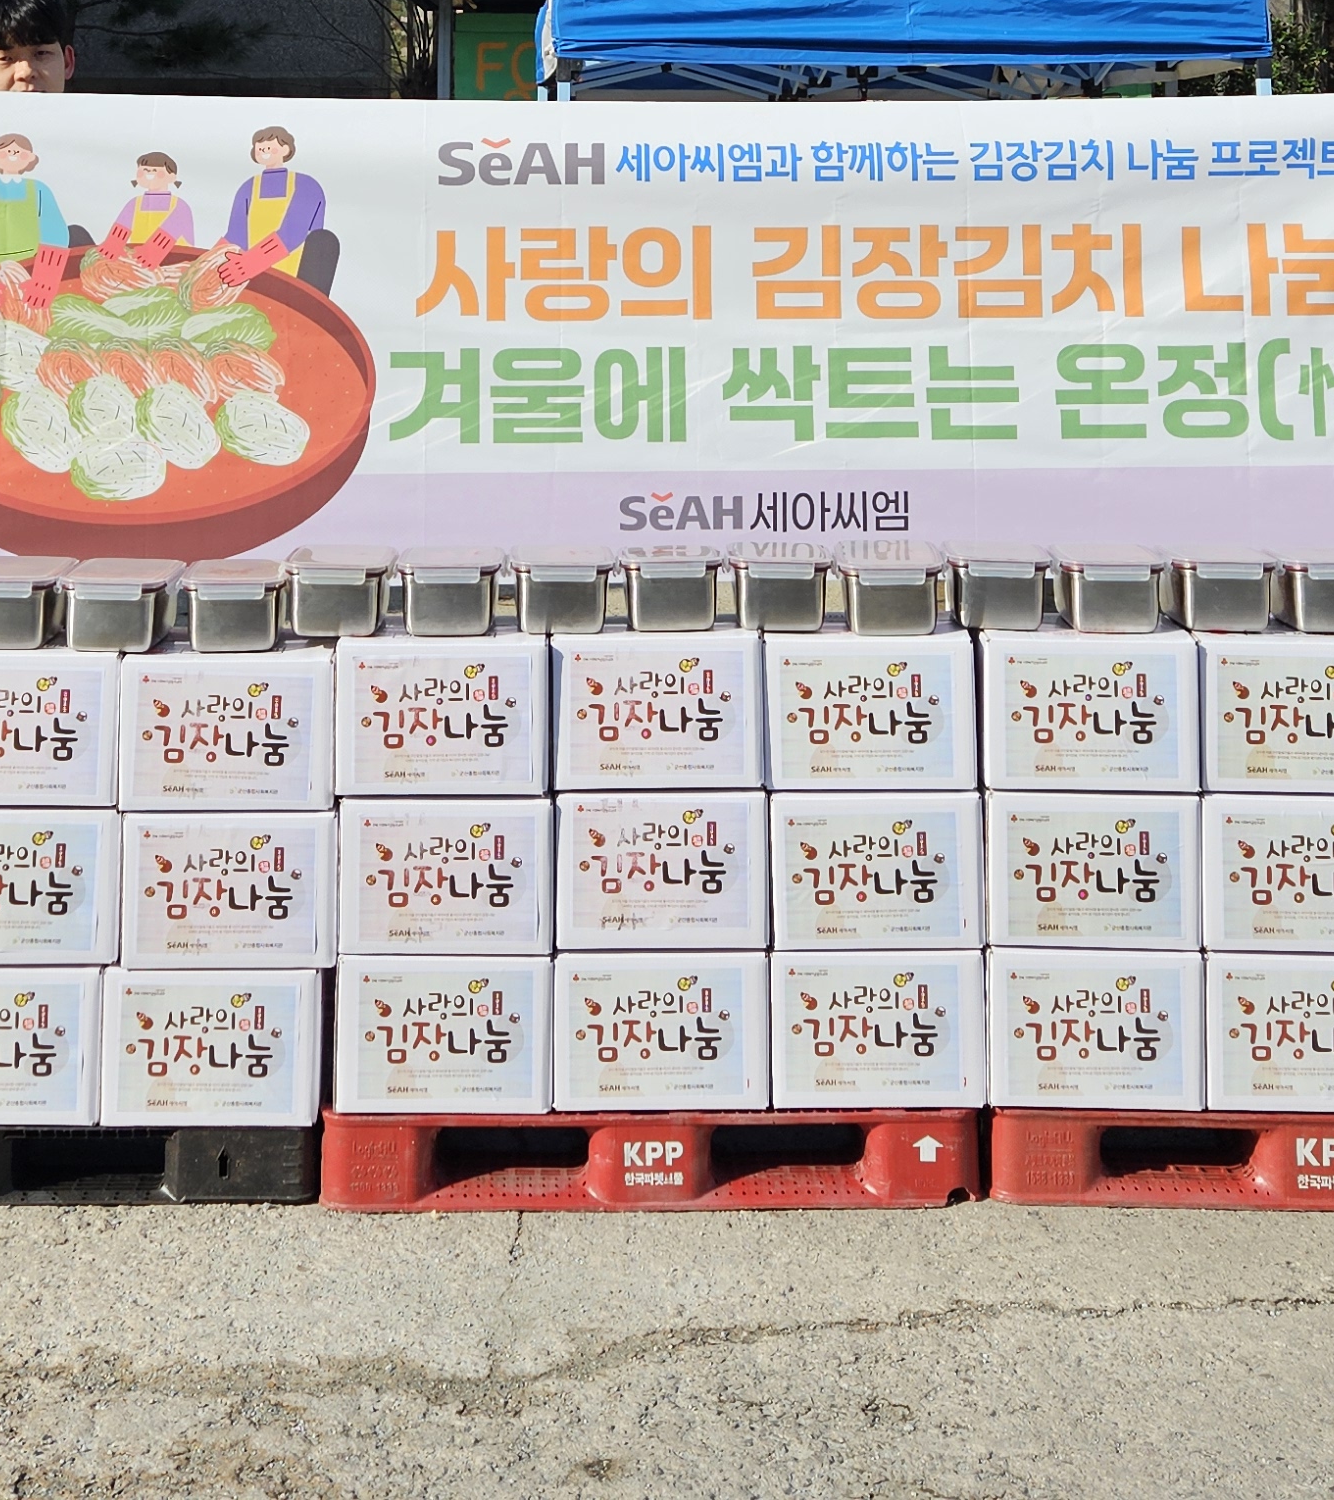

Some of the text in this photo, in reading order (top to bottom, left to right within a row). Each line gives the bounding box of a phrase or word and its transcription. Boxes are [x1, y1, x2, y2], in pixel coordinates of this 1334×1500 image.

[615, 142, 802, 182] 세아씨엠과
[811, 141, 959, 182] 함께하는
[969, 140, 1114, 182] 김장김치
[1127, 138, 1199, 181] 나눔
[416, 225, 712, 321] 사랑의
[753, 223, 1144, 320] 김장김치
[389, 346, 686, 444] 겨울에
[722, 345, 1019, 442] 싹트는
[749, 490, 910, 533] 세아씨엠
[399, 675, 472, 705] 사랑의
[614, 669, 687, 698] 사랑의
[823, 673, 895, 702] 사랑의
[1048, 672, 1120, 701] 사랑의
[1260, 675, 1332, 703] 사랑의
[181, 693, 255, 722] 사랑의
[373, 703, 509, 749] 김장나눔
[588, 697, 723, 742] 김장나눔
[798, 701, 932, 744] 김장나눔
[1022, 700, 1157, 744] 김장나눔
[154, 722, 290, 767] 김장나눔
[404, 834, 477, 864] 사랑의
[617, 820, 690, 850] 사랑의
[828, 831, 900, 861] 사랑의
[1051, 830, 1123, 859] 사랑의
[183, 846, 258, 876] 사랑의
[590, 849, 727, 894] 김장나눔
[803, 859, 938, 905] 김장나눔
[1025, 858, 1160, 903] 김장나눔
[156, 875, 293, 920] 김장나눔
[377, 863, 514, 908] 김장나눔
[164, 1004, 238, 1033] 사랑의
[403, 990, 476, 1020] 사랑의
[613, 987, 685, 1017] 사랑의
[829, 983, 901, 1013] 사랑의
[1051, 987, 1123, 1017] 사랑의
[137, 1033, 273, 1078] 김장나눔
[376, 1019, 512, 1064] 김장나눔
[587, 1016, 722, 1062] 김장나눔
[803, 1012, 938, 1057] 김장나눔
[1025, 1016, 1161, 1061] 김장나눔
[623, 1140, 684, 1168] KPP
